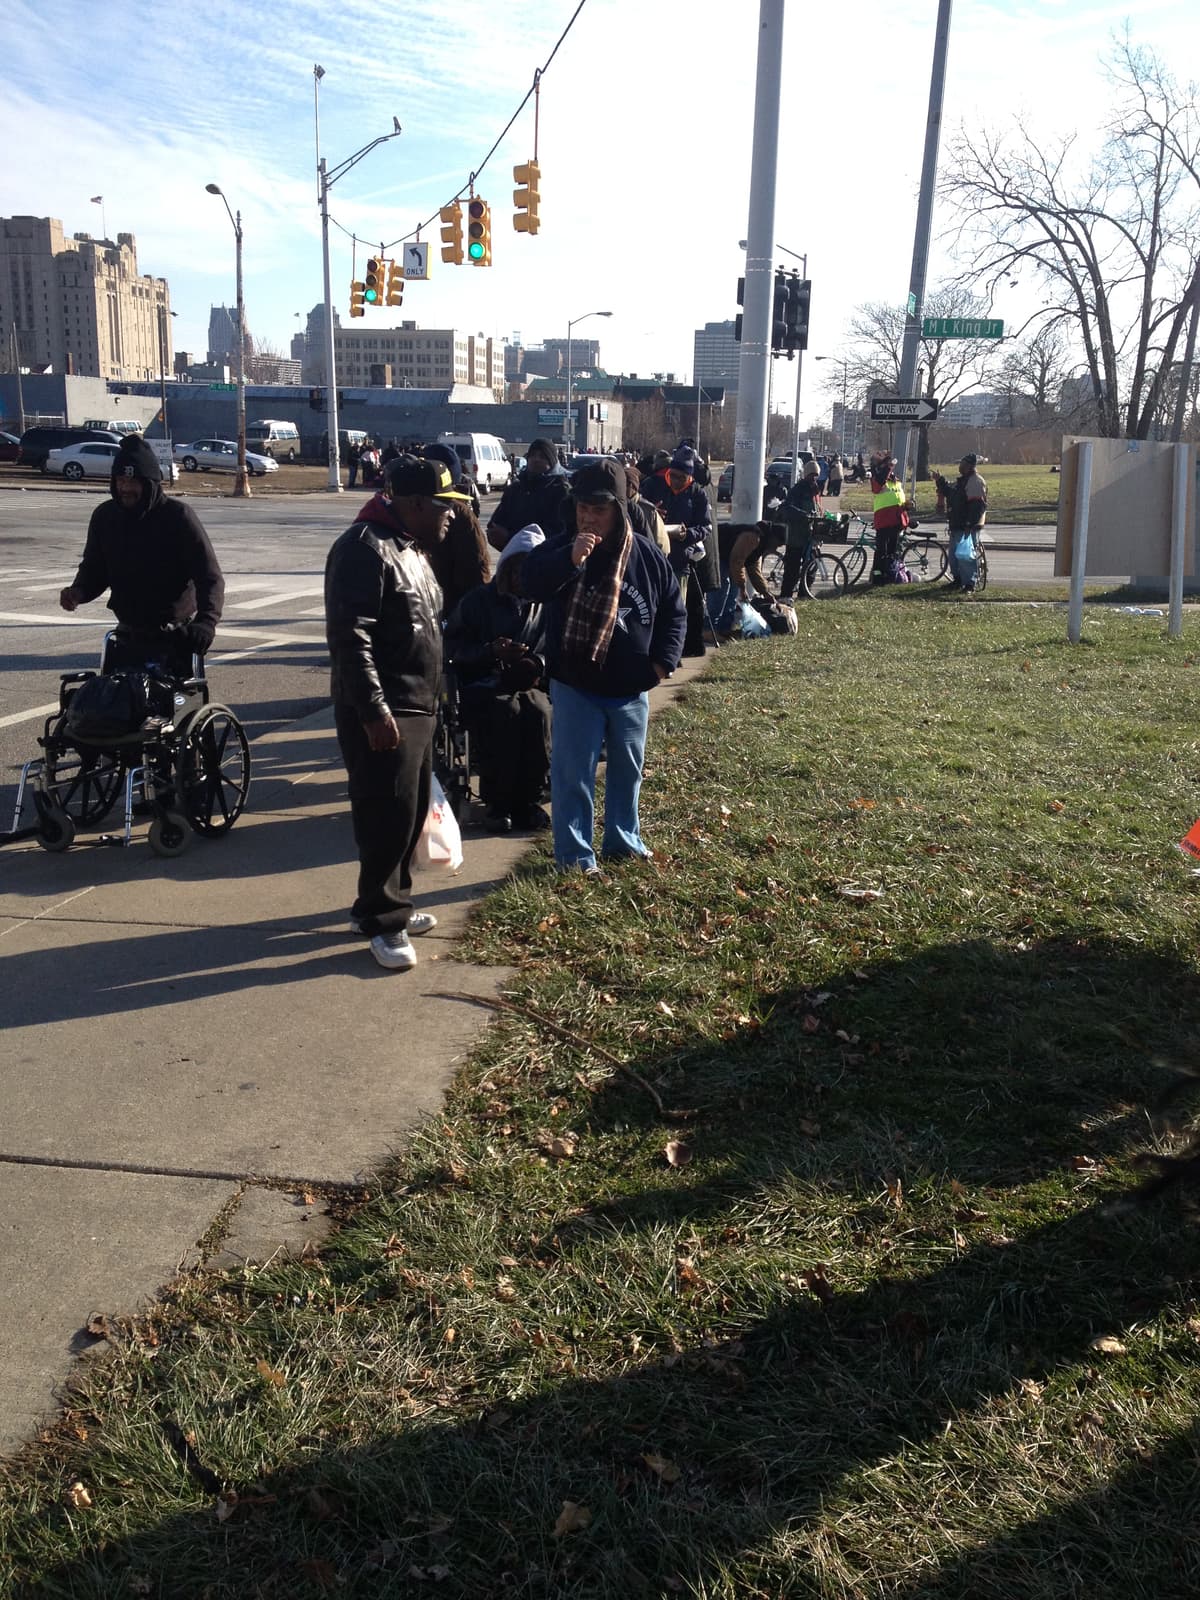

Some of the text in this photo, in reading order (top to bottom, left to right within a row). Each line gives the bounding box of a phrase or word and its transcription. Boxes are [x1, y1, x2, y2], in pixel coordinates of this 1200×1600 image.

[929, 319, 998, 336] M L King Jr
[877, 405, 918, 414] ONE WAY
[627, 585, 650, 625] COWBOYS
